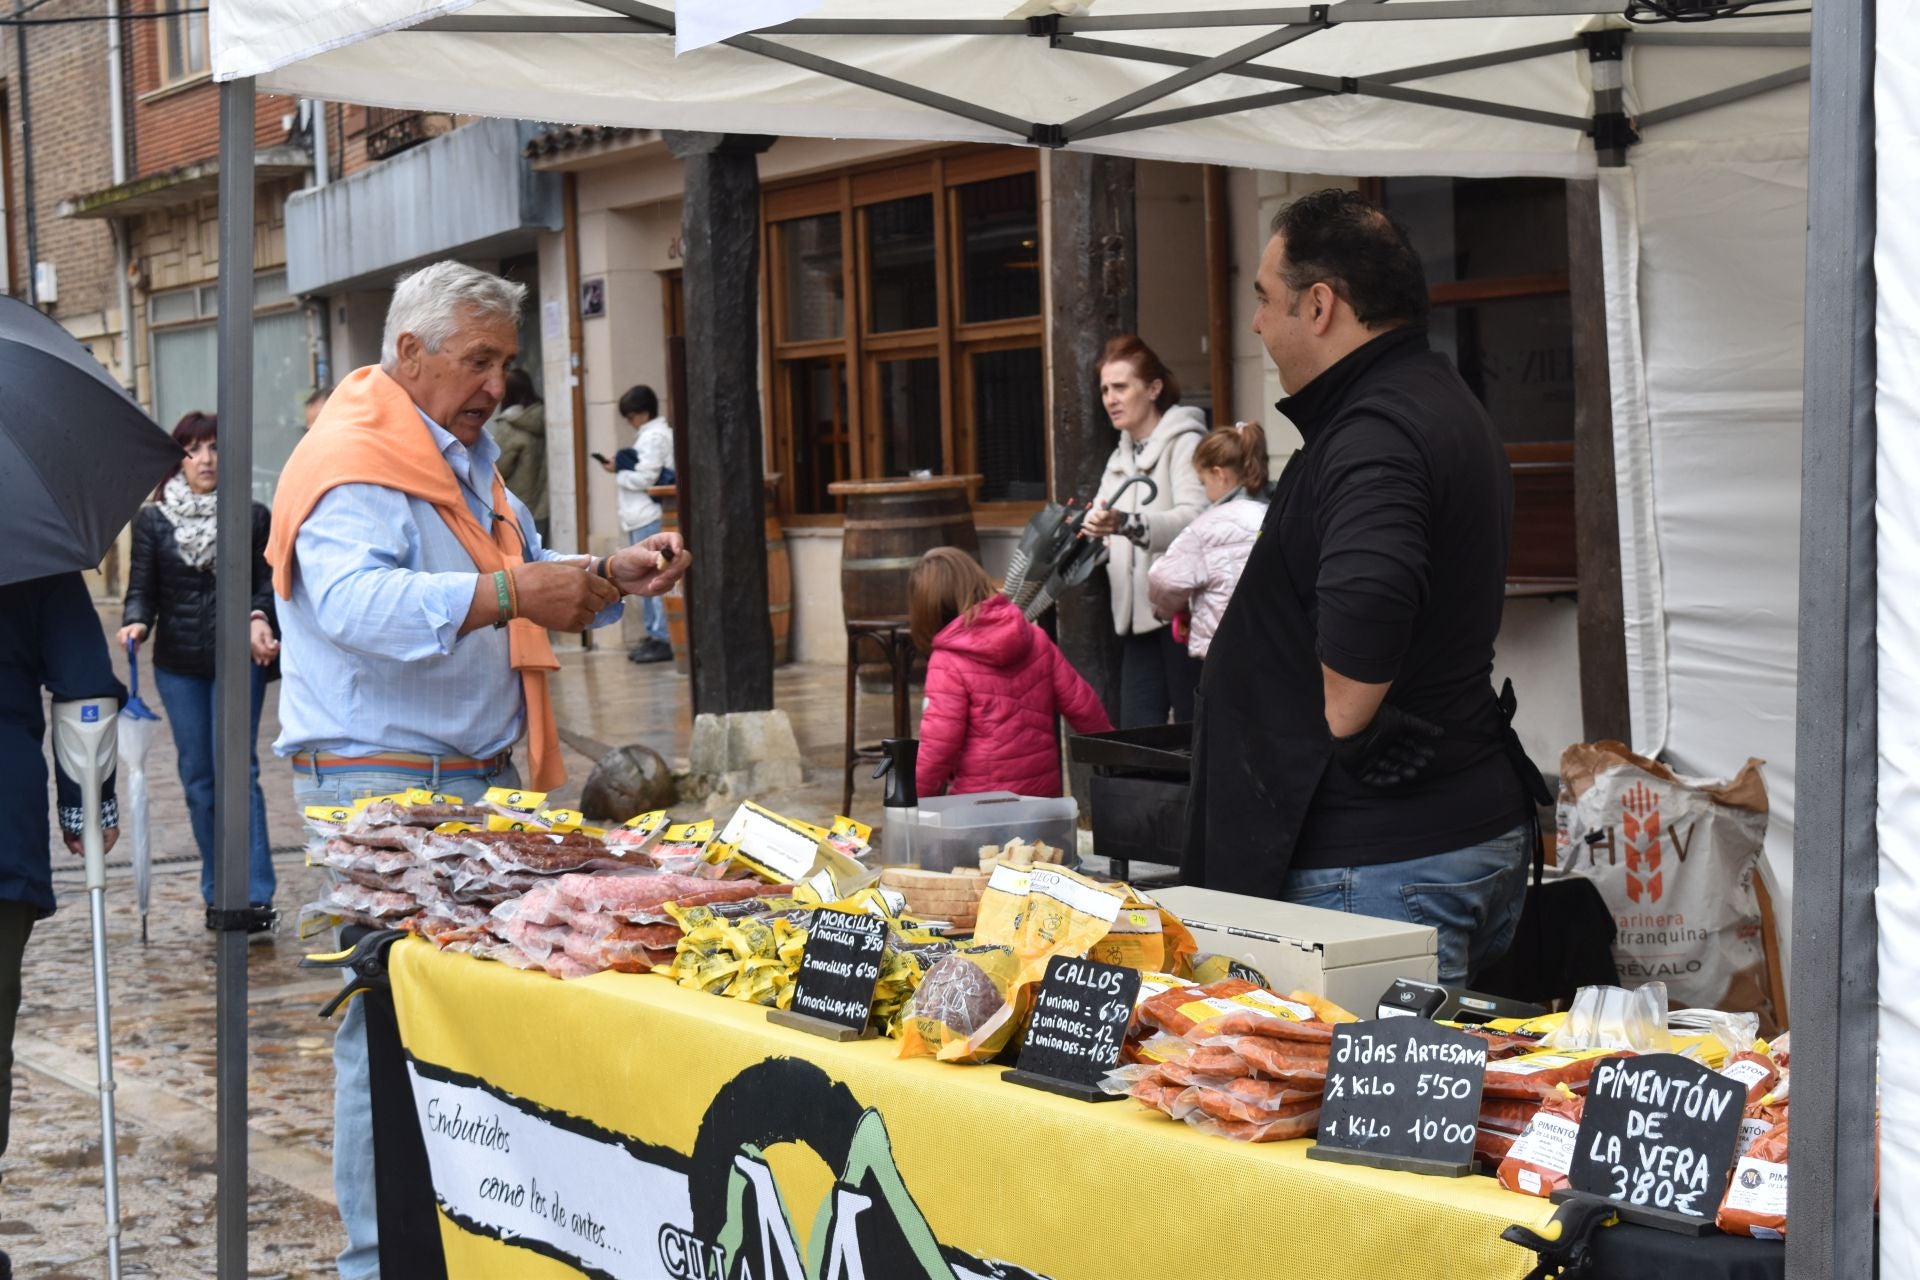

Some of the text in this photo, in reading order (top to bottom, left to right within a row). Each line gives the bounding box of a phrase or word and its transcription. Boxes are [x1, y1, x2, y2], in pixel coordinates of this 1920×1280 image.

[1588, 824, 1617, 866] H
[1668, 822, 1695, 863] V
[1613, 912, 1685, 929] arinera
[808, 922, 818, 940] 1
[861, 935, 884, 952] 3'50
[1613, 927, 1708, 946] franquina
[803, 953, 811, 968] 2
[855, 962, 878, 979] 6'50
[1054, 962, 1124, 995] CALLOS
[1615, 959, 1702, 977] RÉVALO
[796, 985, 804, 1004] 4
[1037, 988, 1046, 1006] 1
[1098, 999, 1130, 1023] 6'50
[1032, 1011, 1040, 1027] 2
[1094, 1025, 1114, 1043] 12
[1024, 1029, 1034, 1046] 3
[1087, 1043, 1120, 1064] 16'50
[1405, 1038, 1486, 1068] ARTESANA
[1416, 1074, 1471, 1100] 5'50
[427, 1098, 512, 1154] Embutidos
[1325, 1116, 1337, 1137] 1
[1406, 1115, 1476, 1145] 10'00
[1537, 1120, 1577, 1140] PIMENTÓ
[1627, 1109, 1669, 1139] DE
[1590, 1131, 1621, 1164] LA
[1639, 1142, 1710, 1191] VERA
[1609, 1165, 1704, 1217] 3'80€
[478, 1177, 623, 1255] como los de antes...
